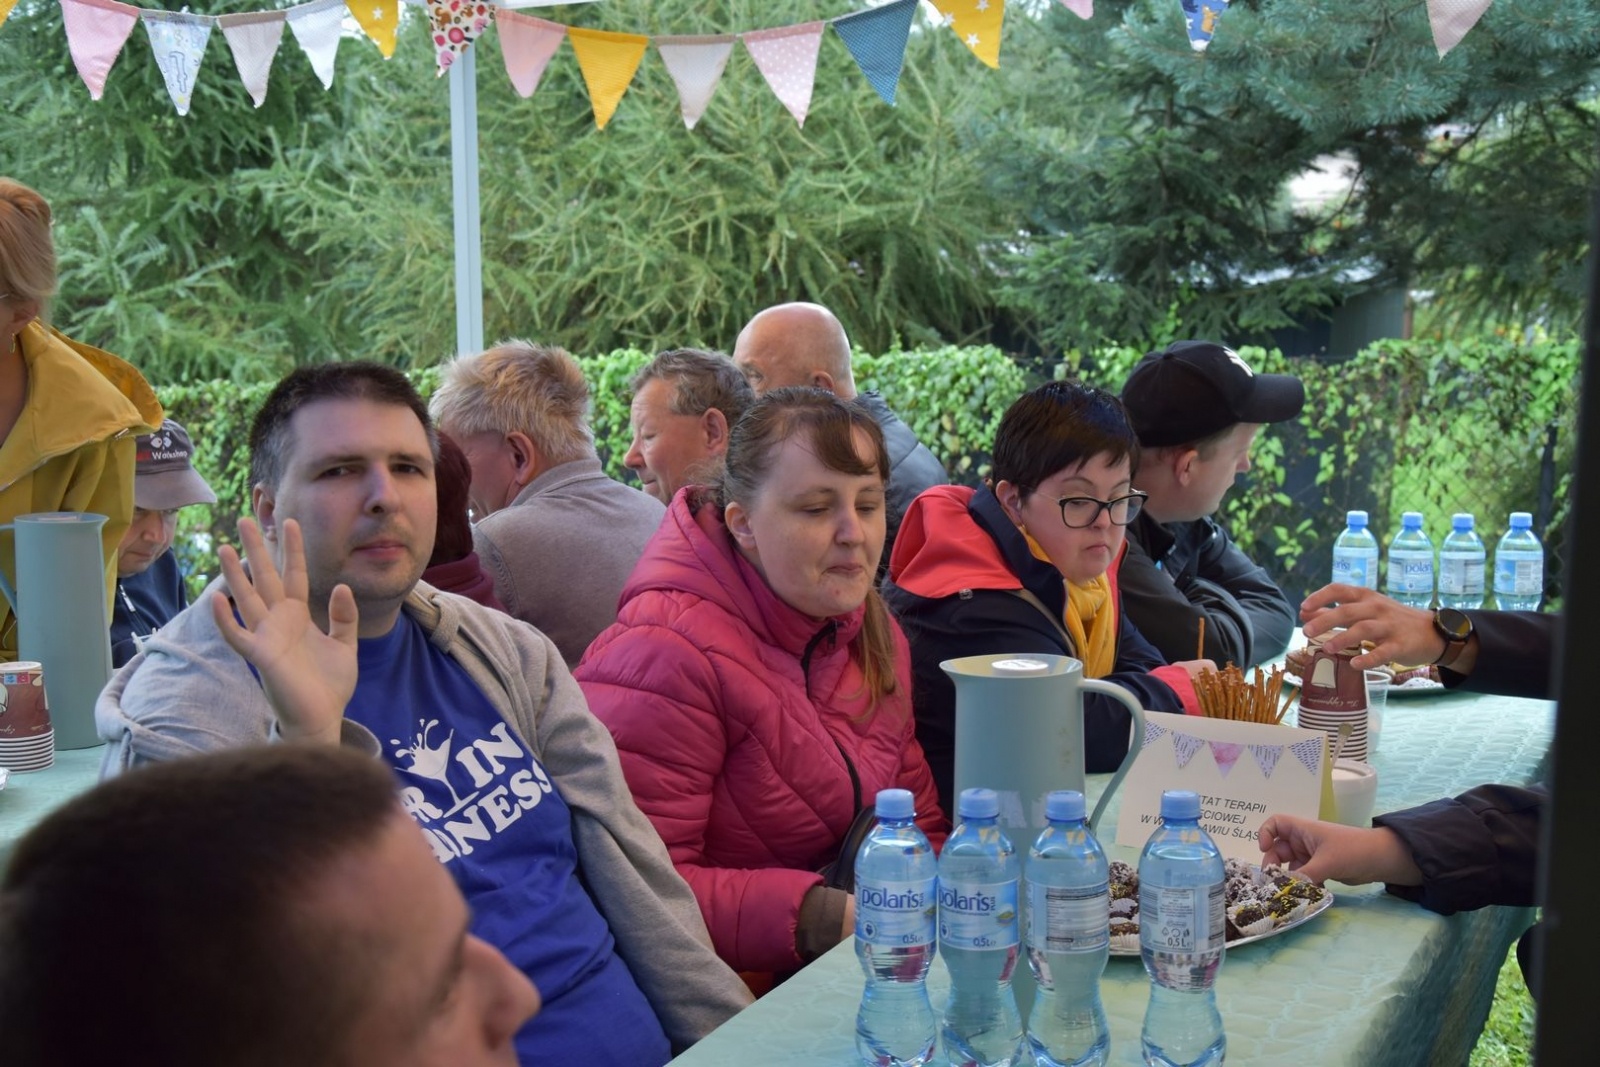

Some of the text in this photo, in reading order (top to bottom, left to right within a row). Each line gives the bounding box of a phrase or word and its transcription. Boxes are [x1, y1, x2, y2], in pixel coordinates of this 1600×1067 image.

[455, 721, 524, 788] IN
[1224, 798, 1267, 814] TERAPII
[1231, 826, 1260, 842] ŚLĄS
[861, 887, 919, 909] polaris
